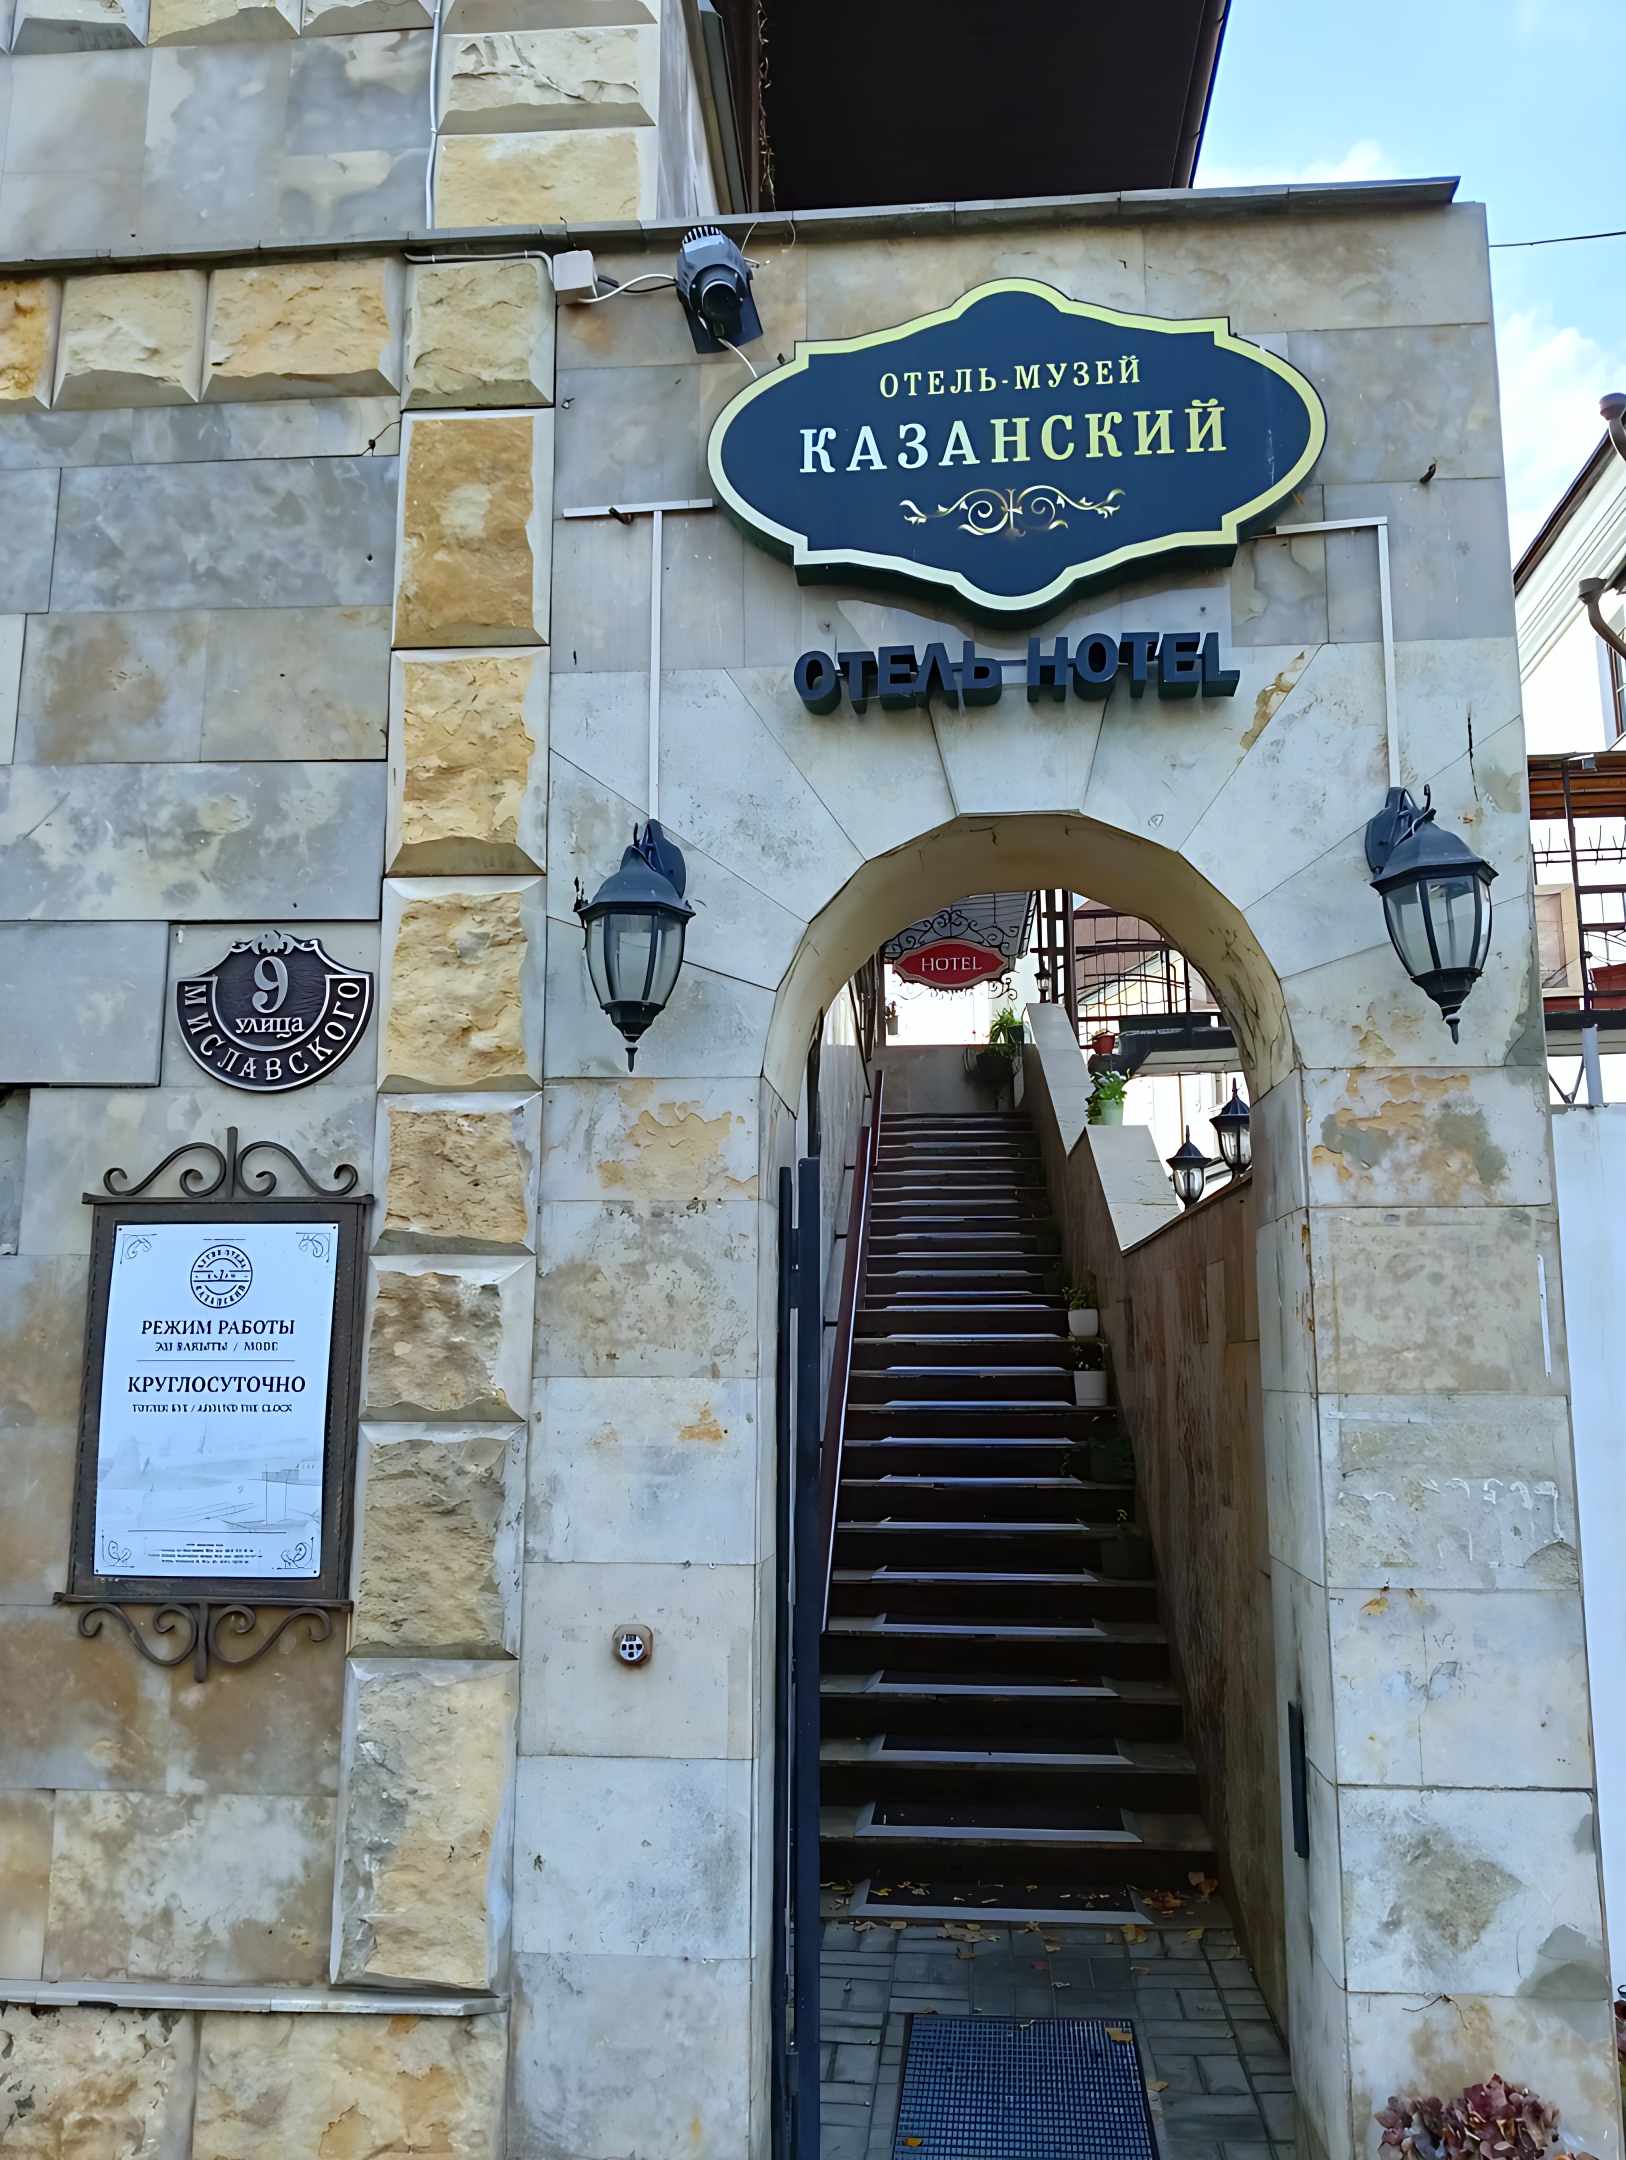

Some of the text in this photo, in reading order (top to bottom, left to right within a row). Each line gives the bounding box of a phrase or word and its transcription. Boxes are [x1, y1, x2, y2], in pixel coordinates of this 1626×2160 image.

[879, 354, 1141, 398] ОТЕЛЬ-МУЗЕЙ
[799, 397, 1228, 474] КАЗАНСКИЙ
[793, 632, 1241, 706] ОТЕЛЬ HOTEL
[251, 955, 290, 1015] 9
[921, 956, 982, 972] HOTEL
[184, 981, 361, 1081] МИСЛАВСКОГО
[234, 1016, 306, 1039] улица
[141, 1319, 295, 1335] РЕЖИМ РАБОТЫ
[127, 1375, 306, 1393] КРУГЛОСУТОЧНО
